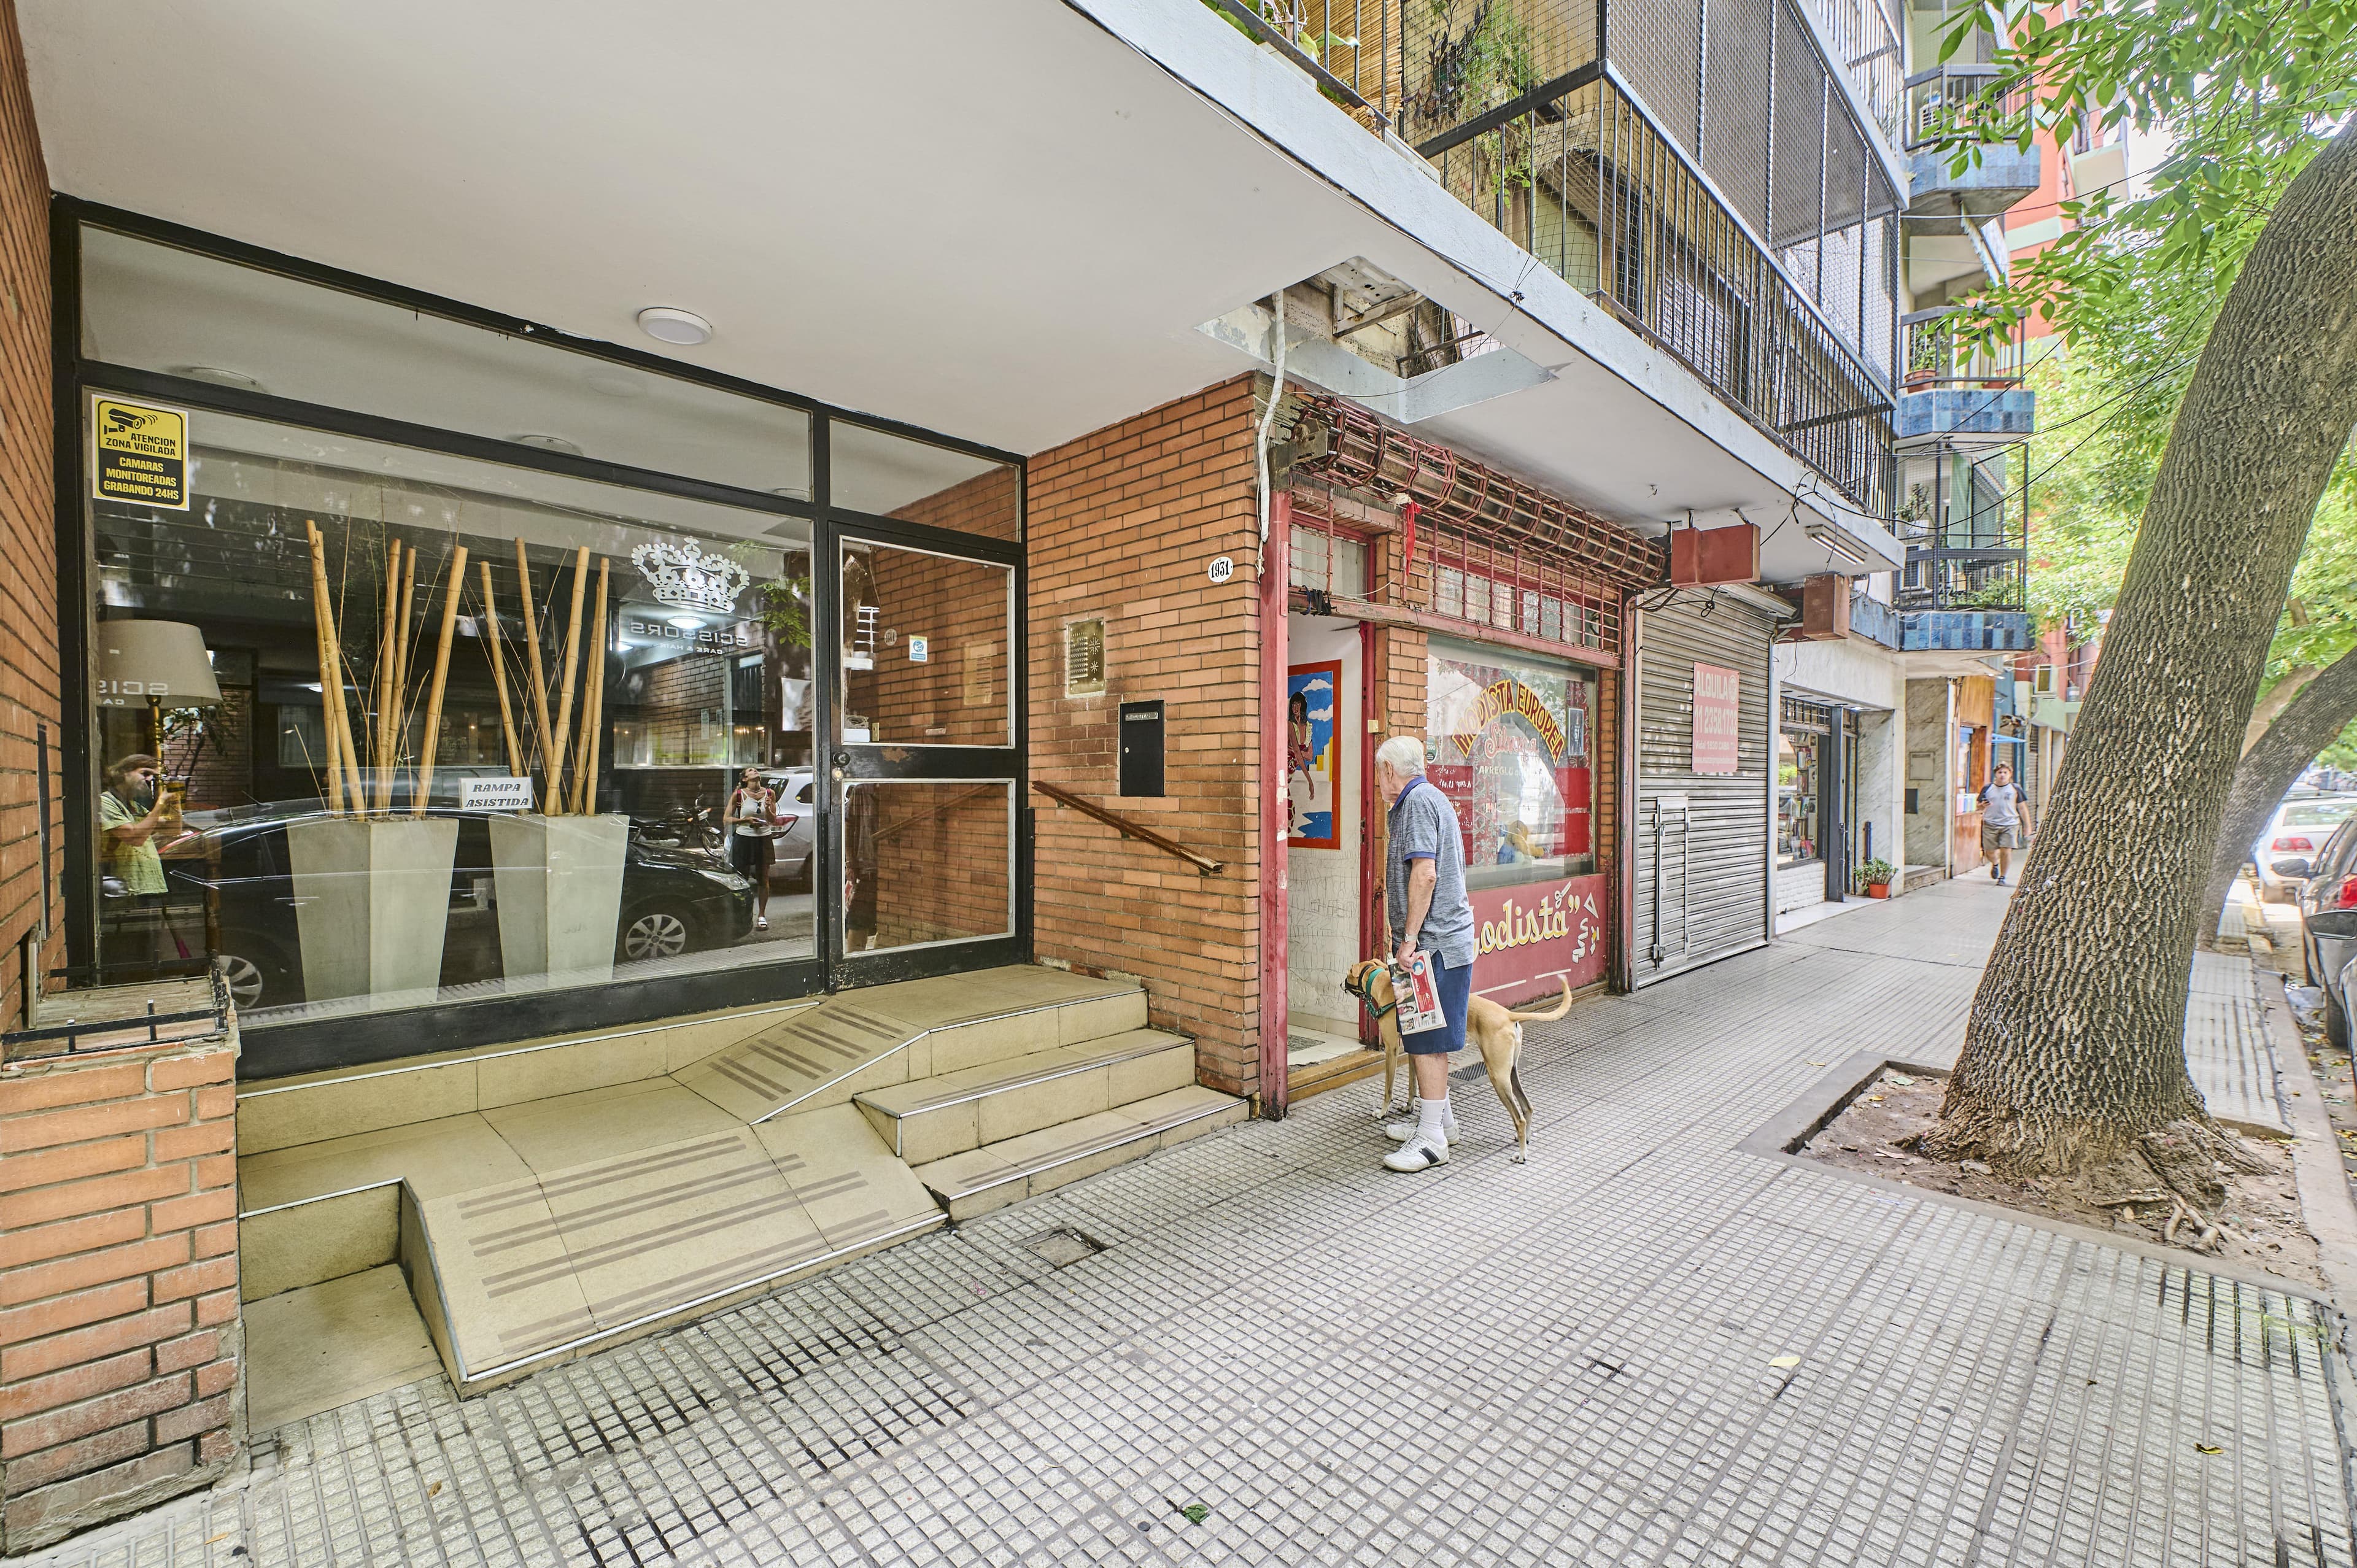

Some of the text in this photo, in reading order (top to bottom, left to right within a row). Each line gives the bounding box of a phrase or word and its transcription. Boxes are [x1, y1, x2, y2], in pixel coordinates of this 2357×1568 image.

[106, 438, 176, 456] ZONA VIGILADA
[131, 433, 176, 447] ATENCION
[119, 457, 164, 473] CAMARAS
[106, 468, 177, 487] MONITOREADAS
[104, 481, 179, 500] GRABANDO 24HS
[1211, 560, 1229, 578] 1931
[1695, 670, 1728, 700] ALQUILA
[1452, 679, 1565, 767] MODISTA EUROPEA
[1694, 705, 1703, 733] 11
[473, 784, 521, 792] RAMPA
[465, 798, 529, 808] ASISTIDA
